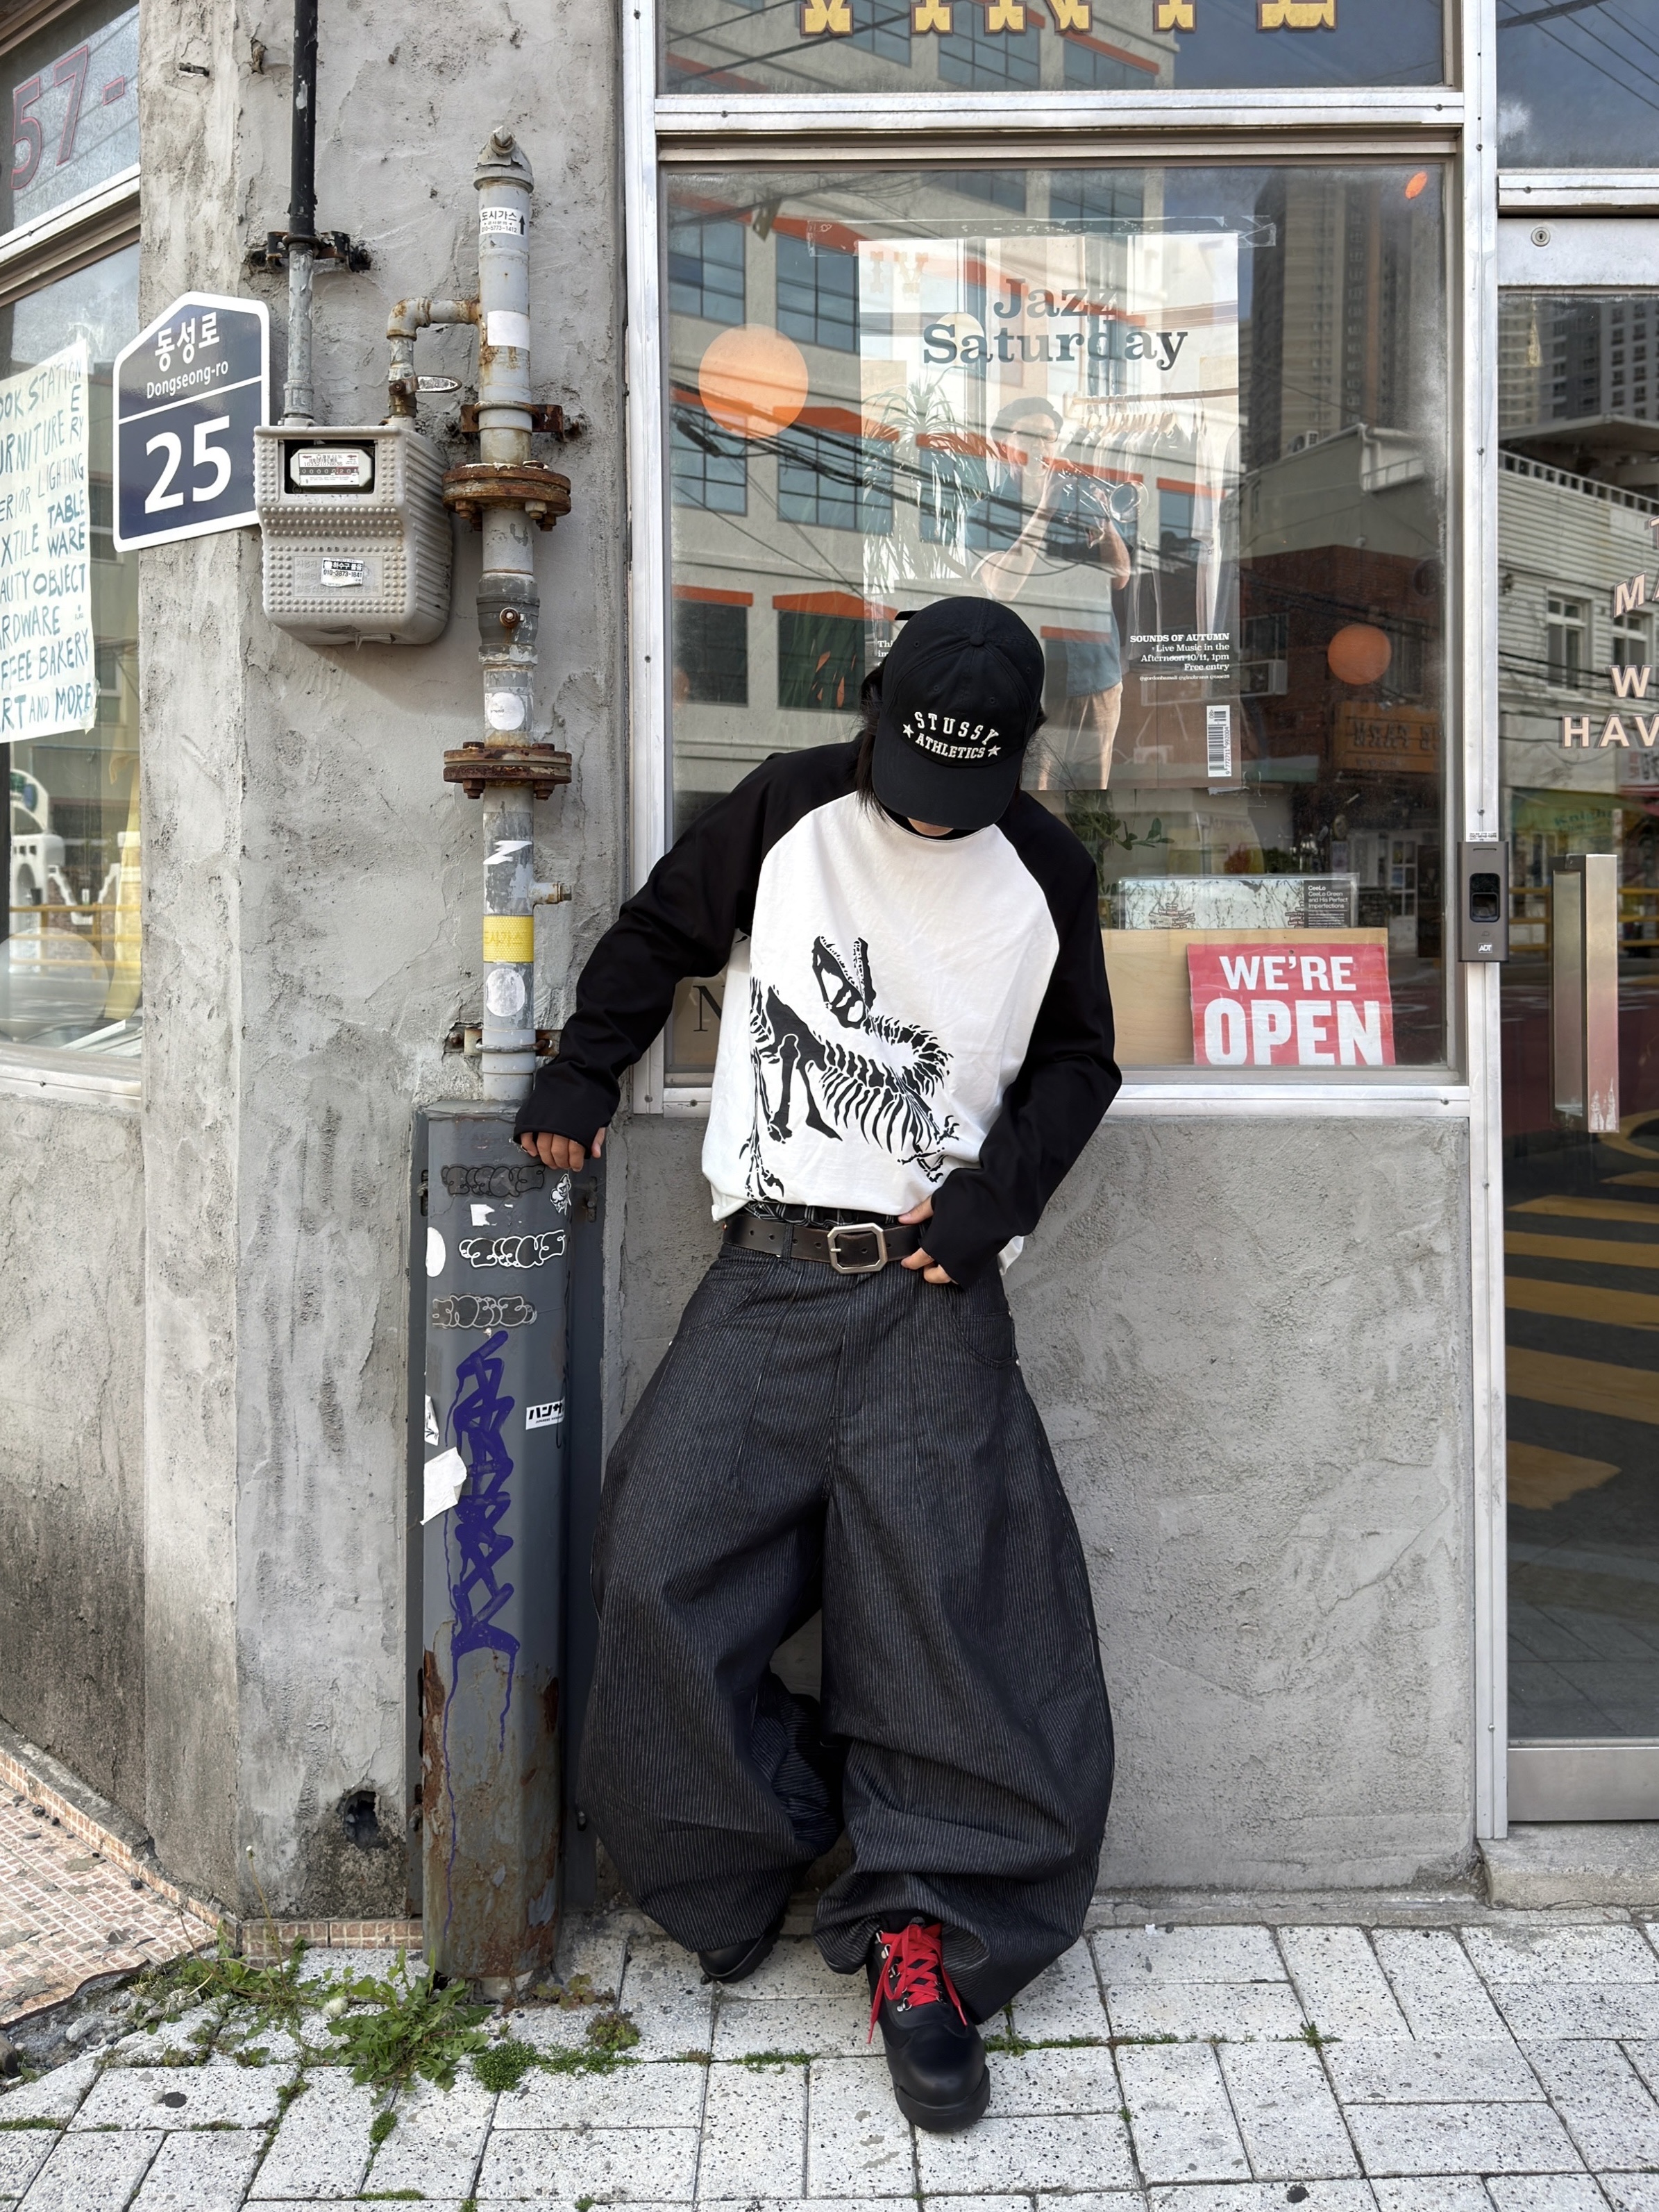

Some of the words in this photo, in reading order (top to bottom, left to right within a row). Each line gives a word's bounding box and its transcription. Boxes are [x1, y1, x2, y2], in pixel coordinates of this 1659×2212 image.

[482, 211, 517, 221] 도시가스
[993, 278, 1119, 319] Jazz
[154, 312, 220, 372] 동성로
[923, 319, 1188, 371] Saturday
[146, 360, 229, 399] Dongseong-ro
[37, 453, 84, 498] LIGHTING
[144, 415, 231, 514] 25
[47, 489, 85, 530] TABLE
[1, 523, 39, 568] XTILE
[47, 521, 85, 558] WARE
[33, 563, 85, 597] OBJECT
[323, 569, 362, 577] 010-3873-1841
[1613, 571, 1659, 618] M
[0, 605, 60, 650] RDWARE
[1130, 634, 1170, 643] SOUNDS
[1186, 633, 1230, 642] AUTUMN
[1, 650, 32, 691] FFEE
[39, 627, 88, 679] BAKERY
[1184, 663, 1204, 671] Free
[1211, 654, 1229, 662] 1pm
[29, 696, 49, 723] AND
[55, 682, 91, 722] MORE
[914, 711, 999, 746] STUSSY
[915, 733, 986, 759] ATHLETICS
[1219, 956, 1357, 991] WE’RE
[1204, 997, 1383, 1065] OPEN
